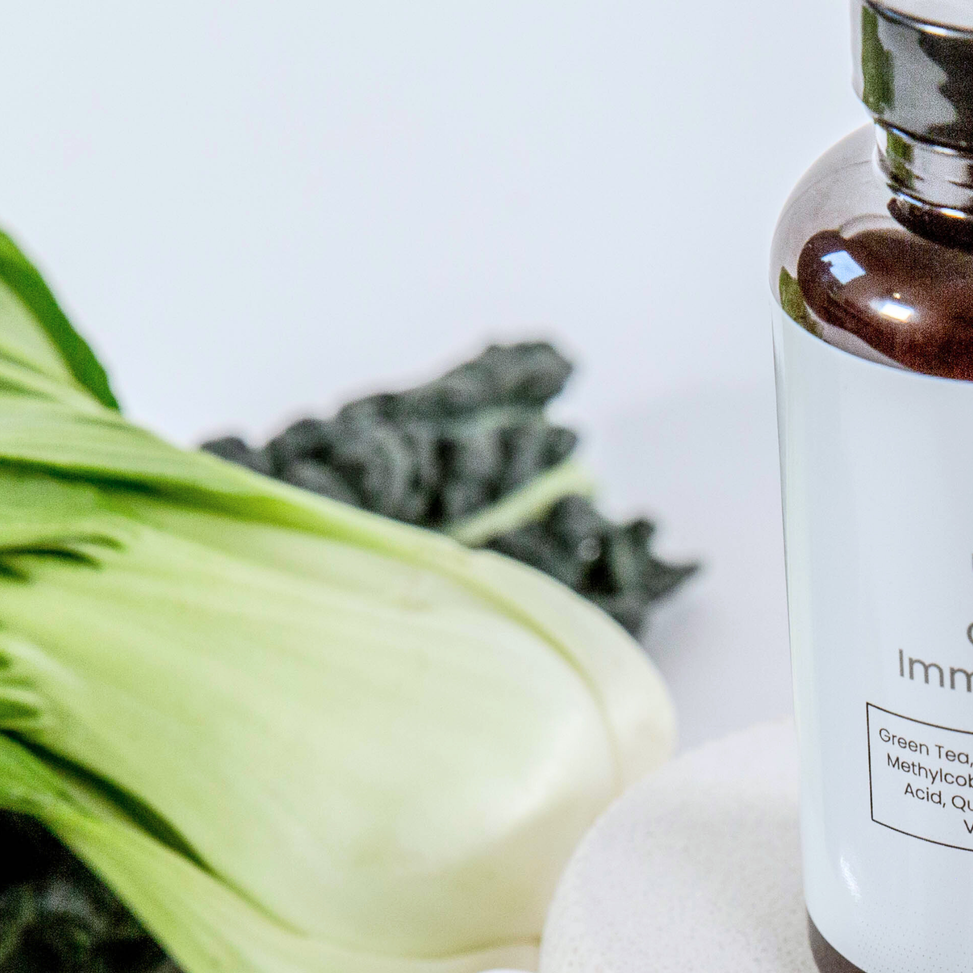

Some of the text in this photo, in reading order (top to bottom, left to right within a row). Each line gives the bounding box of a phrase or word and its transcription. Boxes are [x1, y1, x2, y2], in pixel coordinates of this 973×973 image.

[879, 728, 929, 756] Green
[935, 744, 973, 768] Tea,
[904, 783, 946, 808] Acid,
